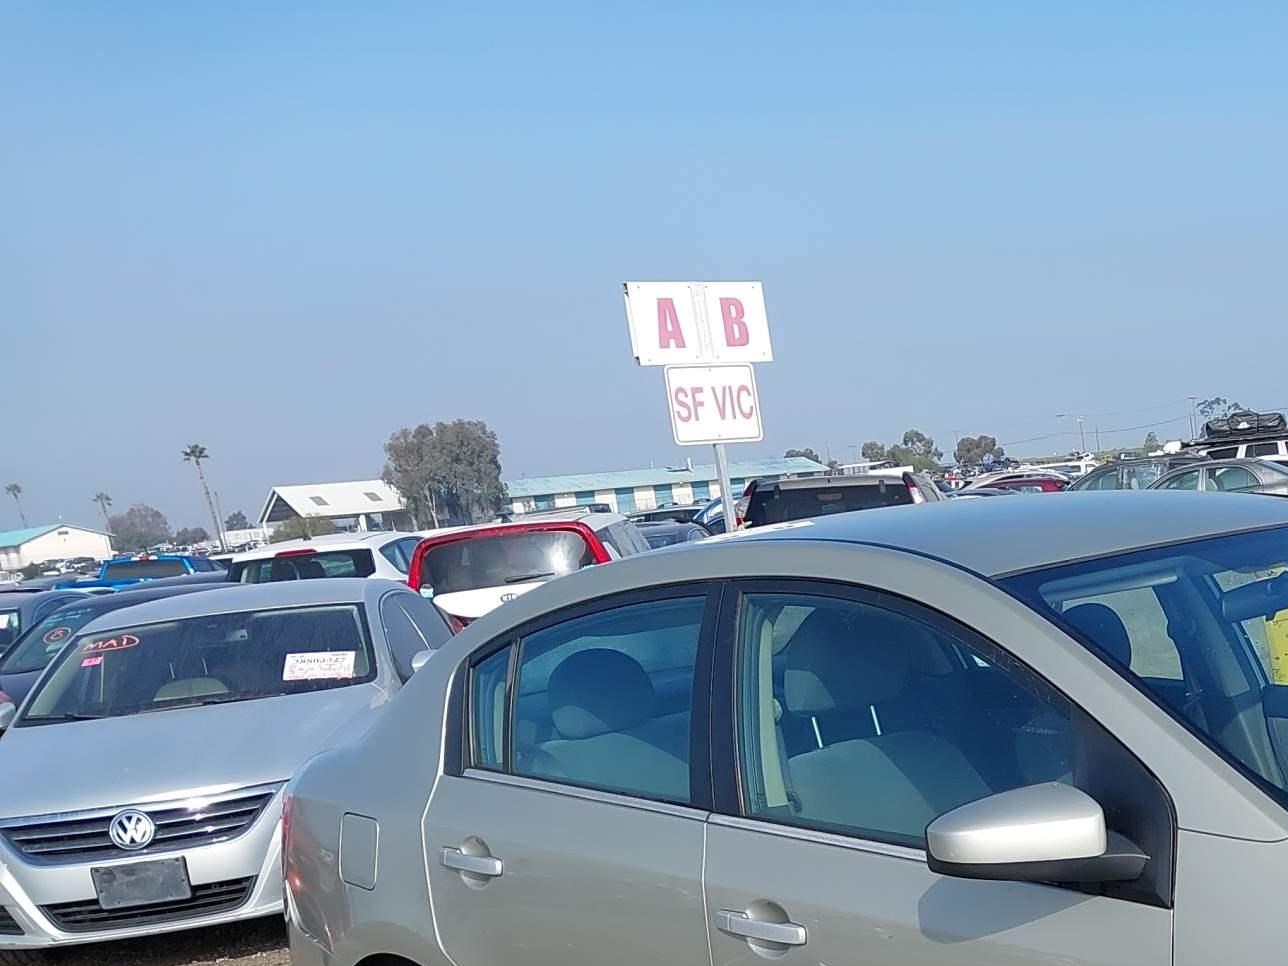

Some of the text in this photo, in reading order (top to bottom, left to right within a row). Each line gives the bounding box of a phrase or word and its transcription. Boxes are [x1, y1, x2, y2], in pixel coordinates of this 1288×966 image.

[656, 297, 750, 349] A B
[674, 385, 754, 423] SF VIC
